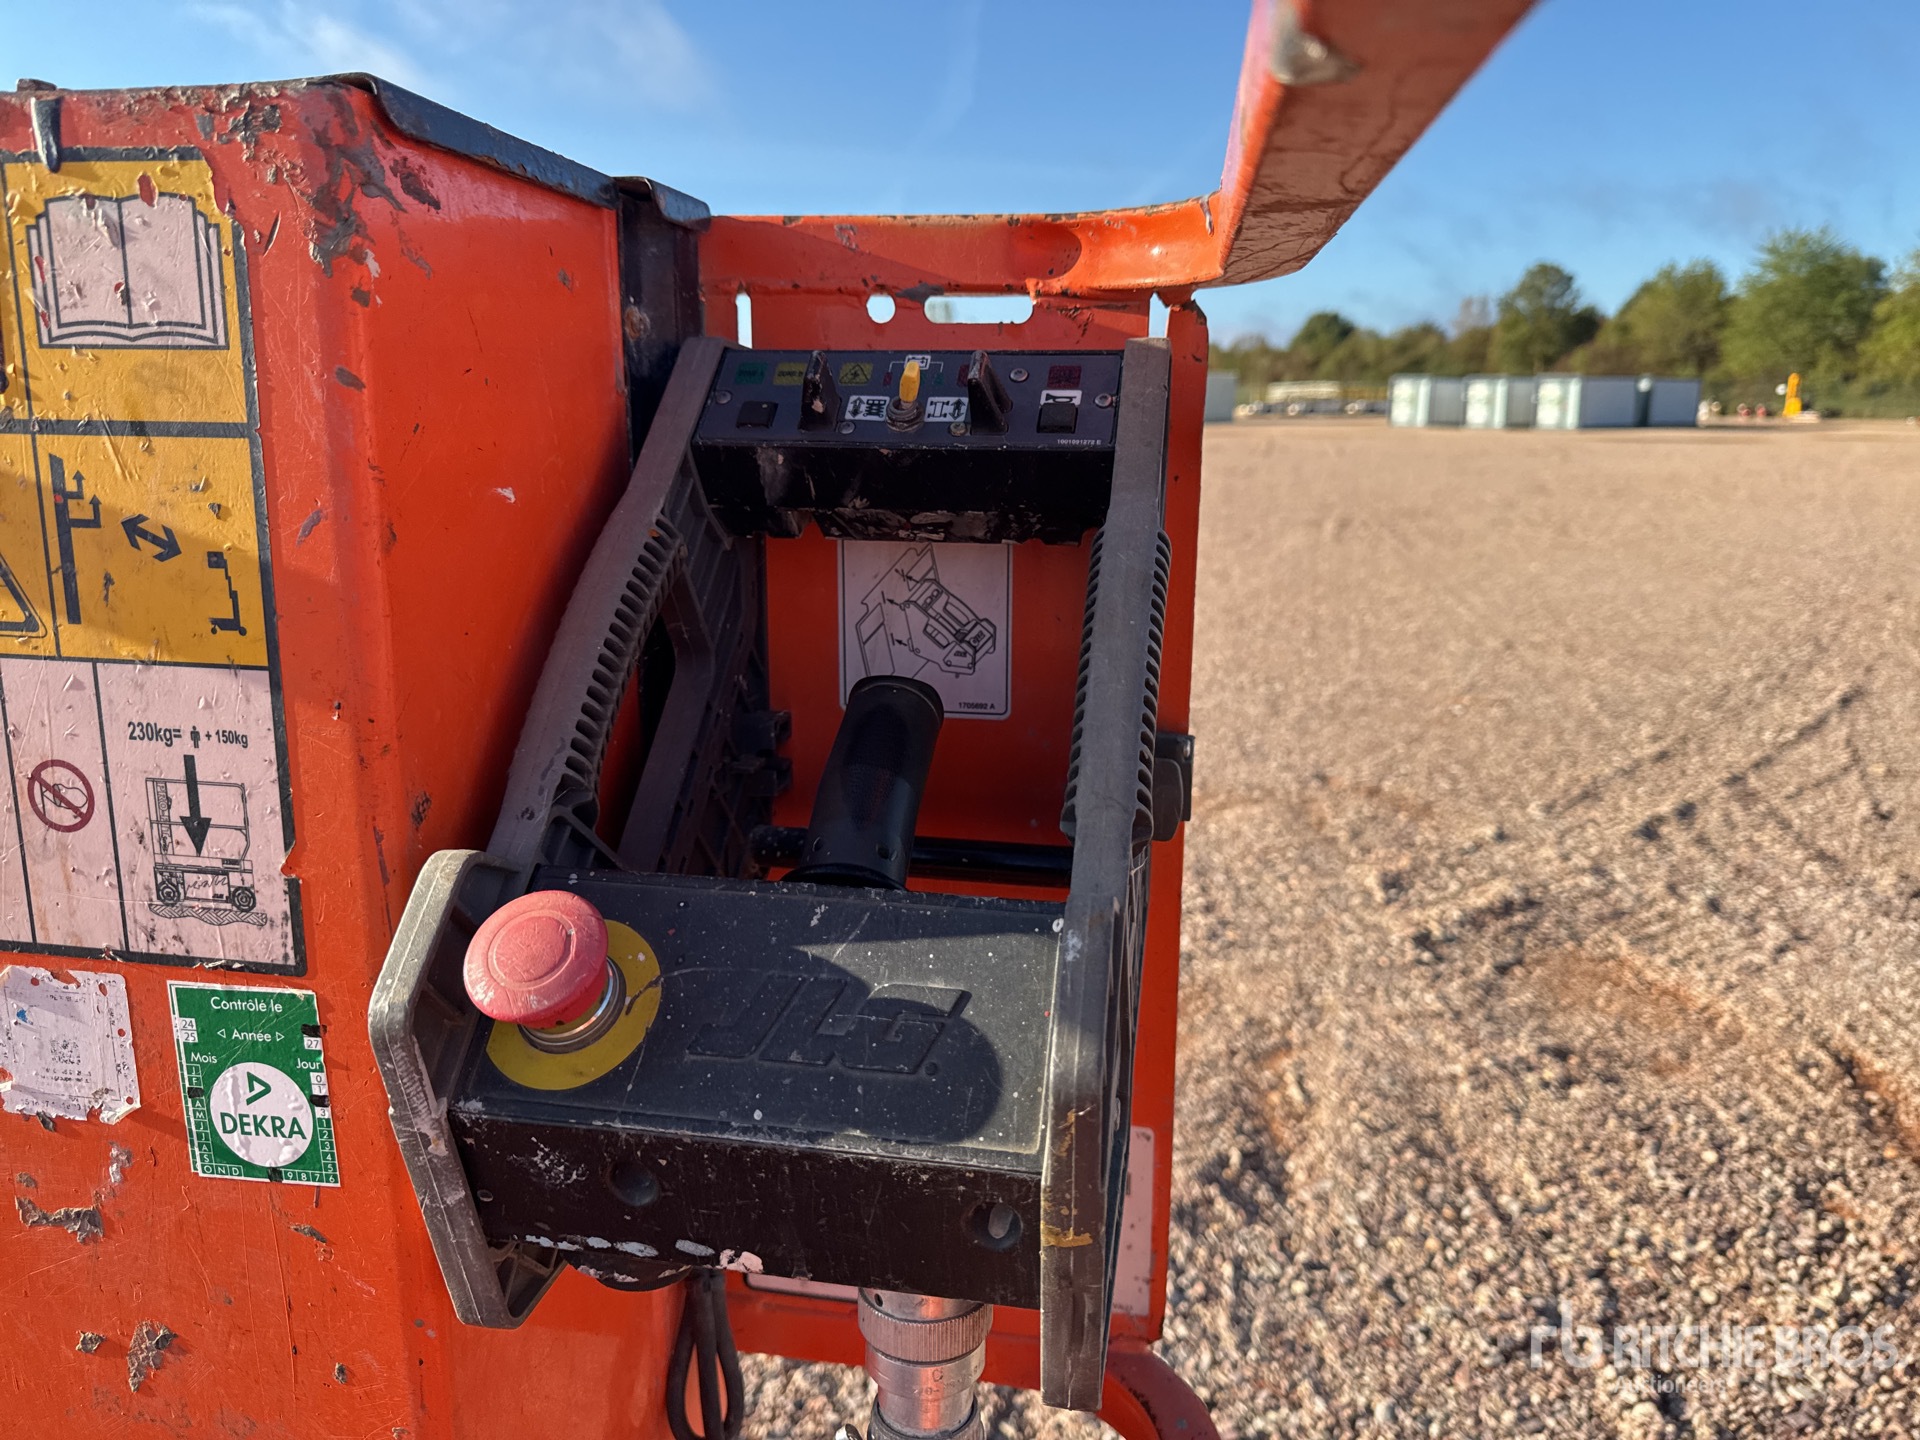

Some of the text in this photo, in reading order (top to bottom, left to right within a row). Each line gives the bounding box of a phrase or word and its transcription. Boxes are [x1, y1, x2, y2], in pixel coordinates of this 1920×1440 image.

[989, 702, 996, 710] A
[215, 729, 248, 748] 150kg
[210, 996, 283, 1013] Contrôlé le
[182, 1019, 194, 1030] 24
[184, 1031, 196, 1042] 25
[231, 1028, 272, 1042] Année
[307, 1039, 320, 1049] 27
[190, 1052, 218, 1063] Mois
[296, 1058, 322, 1070] Jour
[219, 1111, 307, 1140] DEKRA
